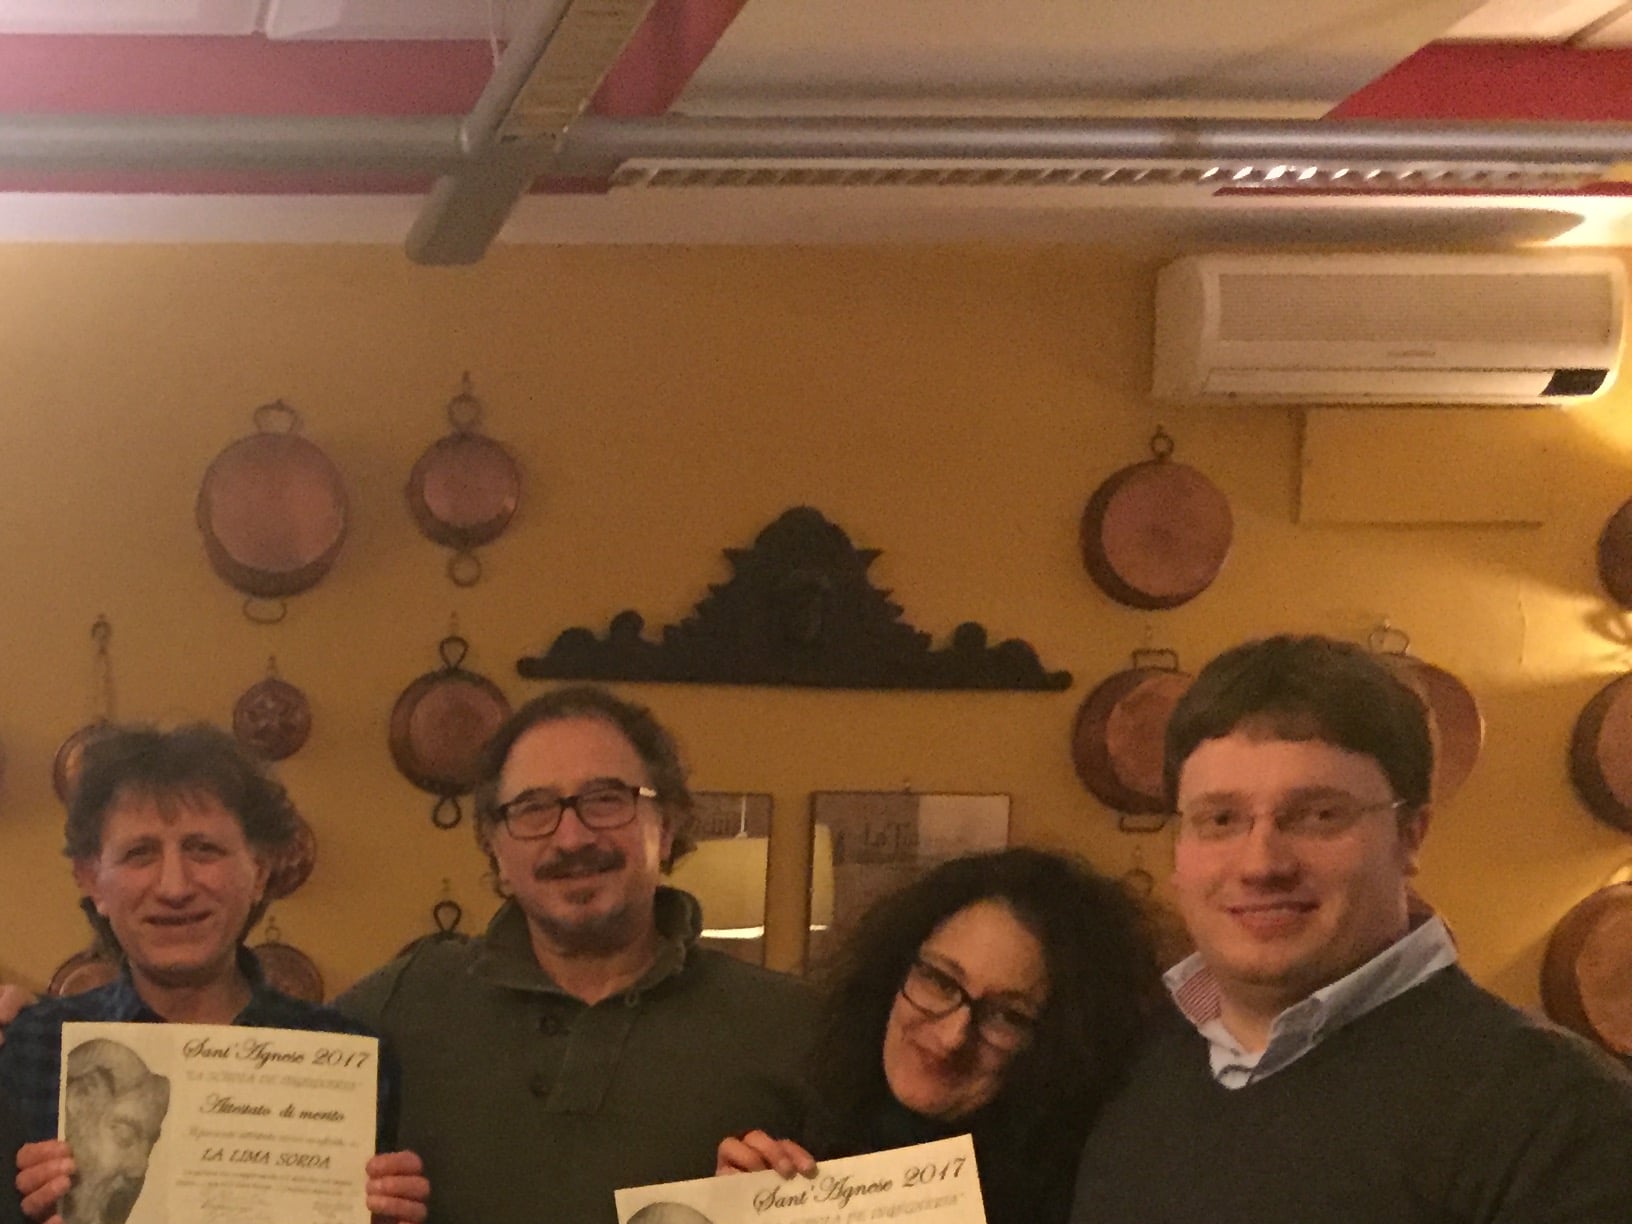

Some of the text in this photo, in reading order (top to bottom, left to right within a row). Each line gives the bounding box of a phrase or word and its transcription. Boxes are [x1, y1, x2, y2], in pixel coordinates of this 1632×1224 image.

[183, 1037, 371, 1069] Sant'Agnese 2017
[200, 1093, 345, 1122] Attestato di merito
[200, 1148, 331, 1169] LA LIMA SORDA
[753, 1157, 966, 1215] Sant'Agnese 2017
